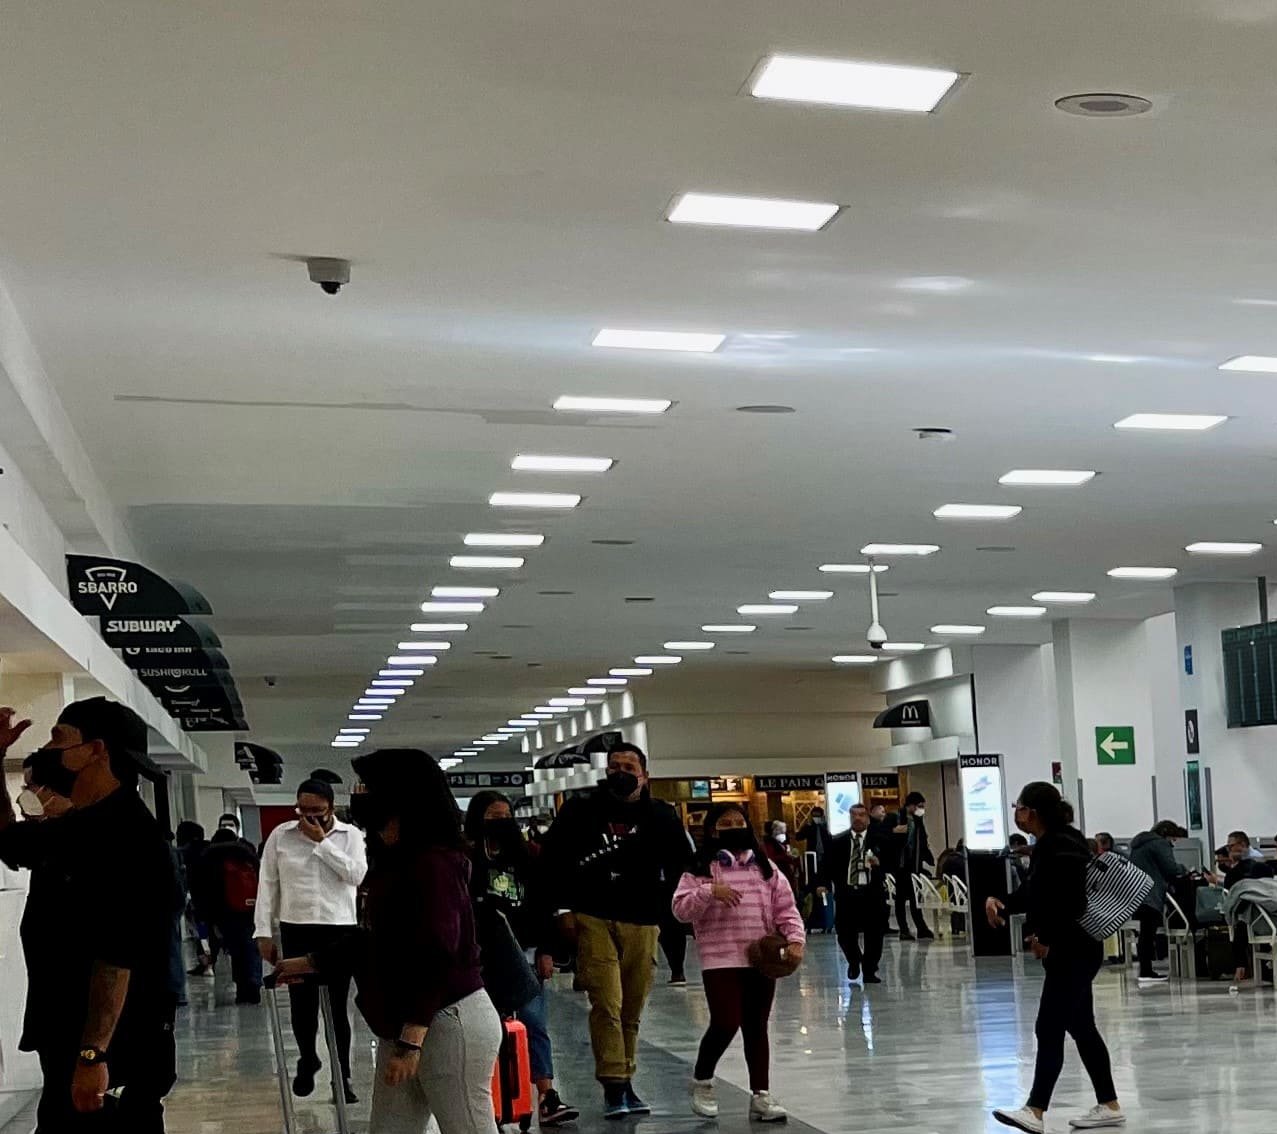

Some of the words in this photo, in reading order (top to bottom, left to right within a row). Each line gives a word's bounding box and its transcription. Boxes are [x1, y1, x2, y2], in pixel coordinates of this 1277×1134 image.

[78, 582, 138, 594] SBARRO
[106, 620, 181, 633] SUBWAY
[961, 757, 997, 766] HONOR
[759, 779, 777, 788] LE
[780, 778, 811, 788] PAIN
